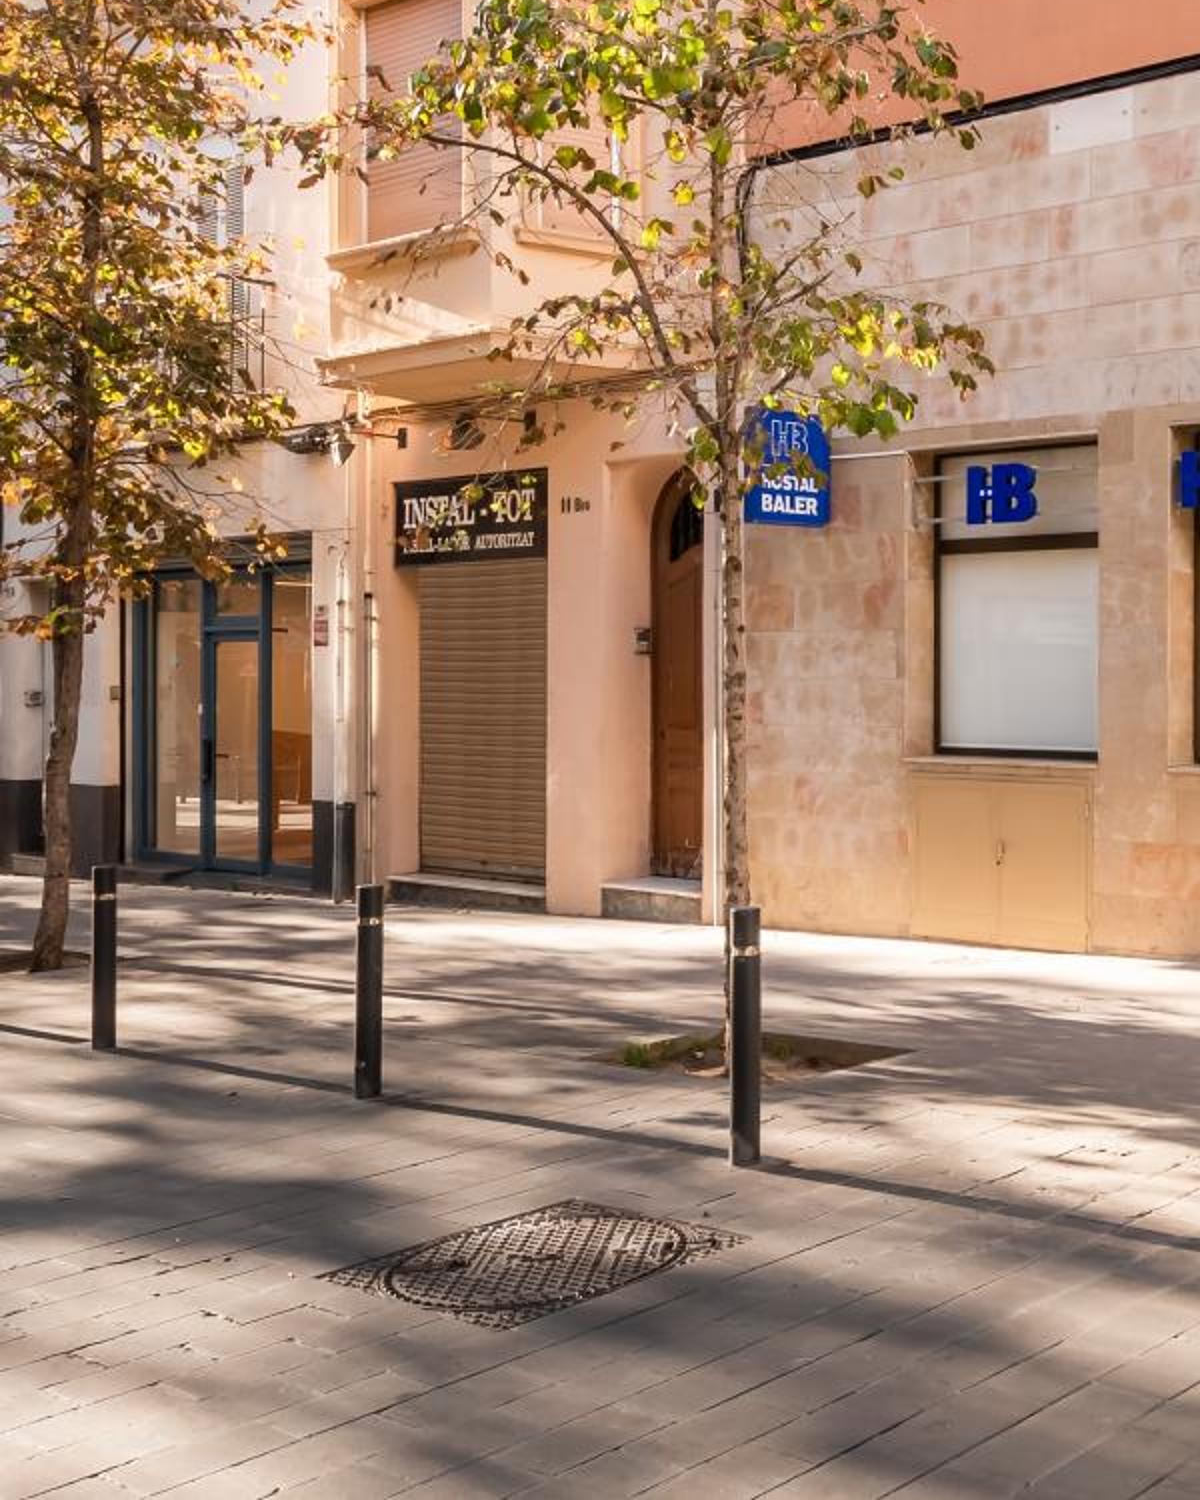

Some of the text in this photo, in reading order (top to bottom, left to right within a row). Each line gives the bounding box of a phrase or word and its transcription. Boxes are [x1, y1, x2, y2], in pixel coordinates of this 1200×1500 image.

[403, 495, 475, 529] INSTAL
[493, 489, 535, 523] TOT
[761, 493, 820, 517] BALER
